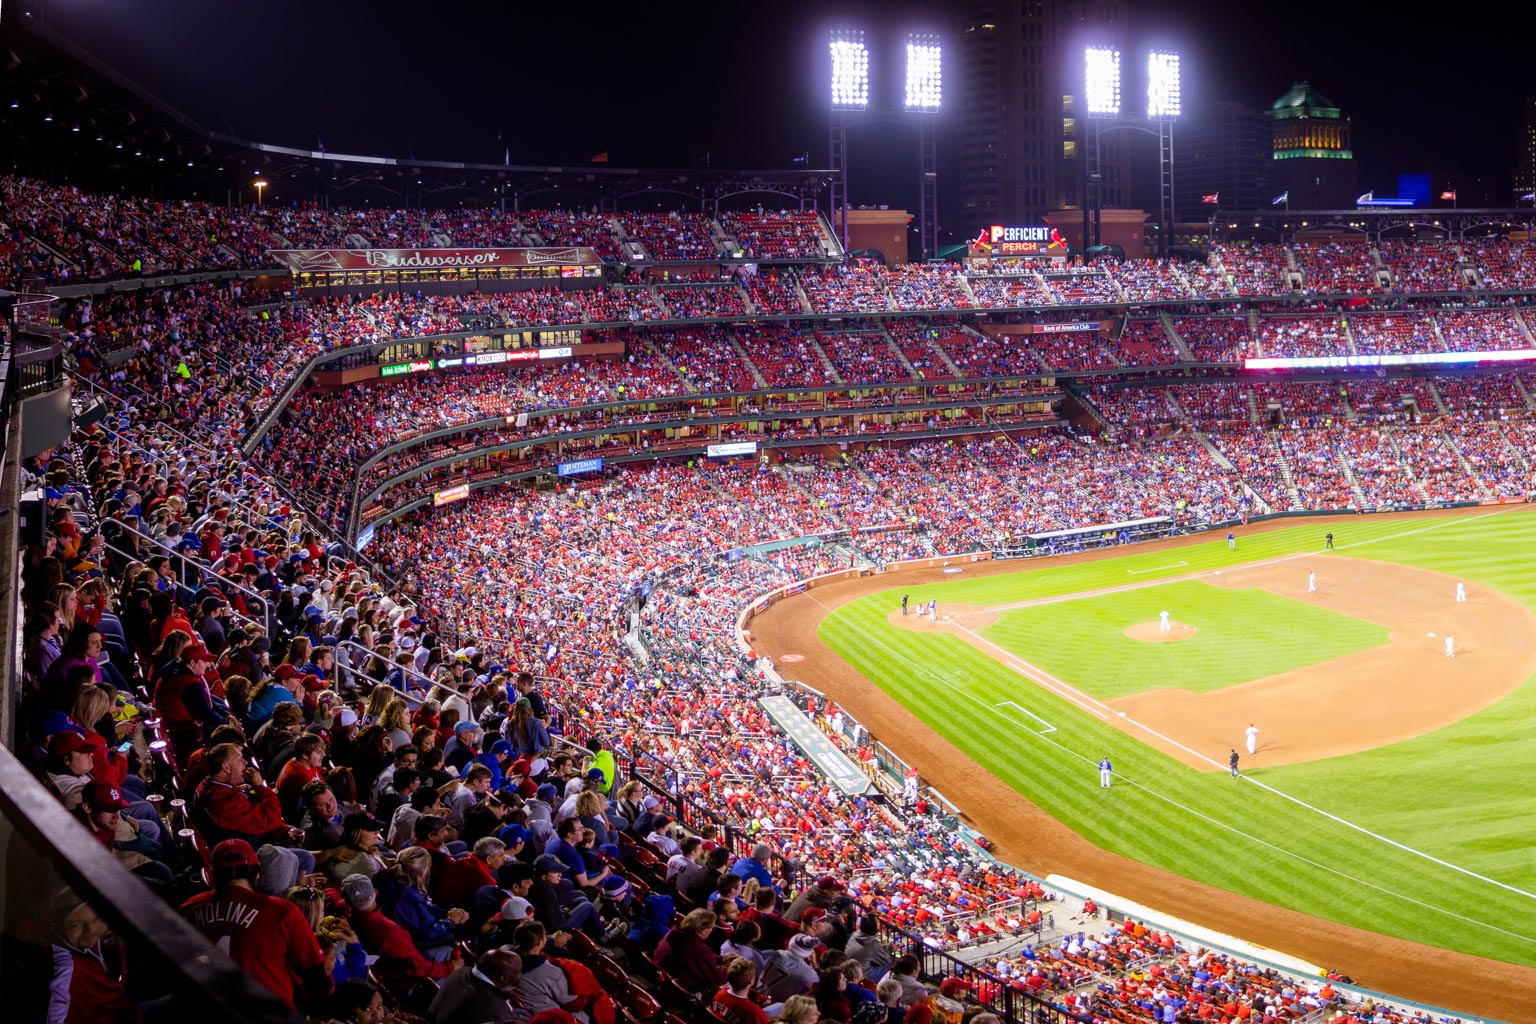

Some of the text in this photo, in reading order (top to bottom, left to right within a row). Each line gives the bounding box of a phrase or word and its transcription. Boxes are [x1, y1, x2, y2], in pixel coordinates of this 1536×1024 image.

[991, 226, 1049, 243] PERFICIENT
[1002, 243, 1037, 251] PERCH
[349, 251, 499, 267] Budweiser
[571, 459, 598, 469] SITEMAN
[194, 901, 260, 929] MOLINA
